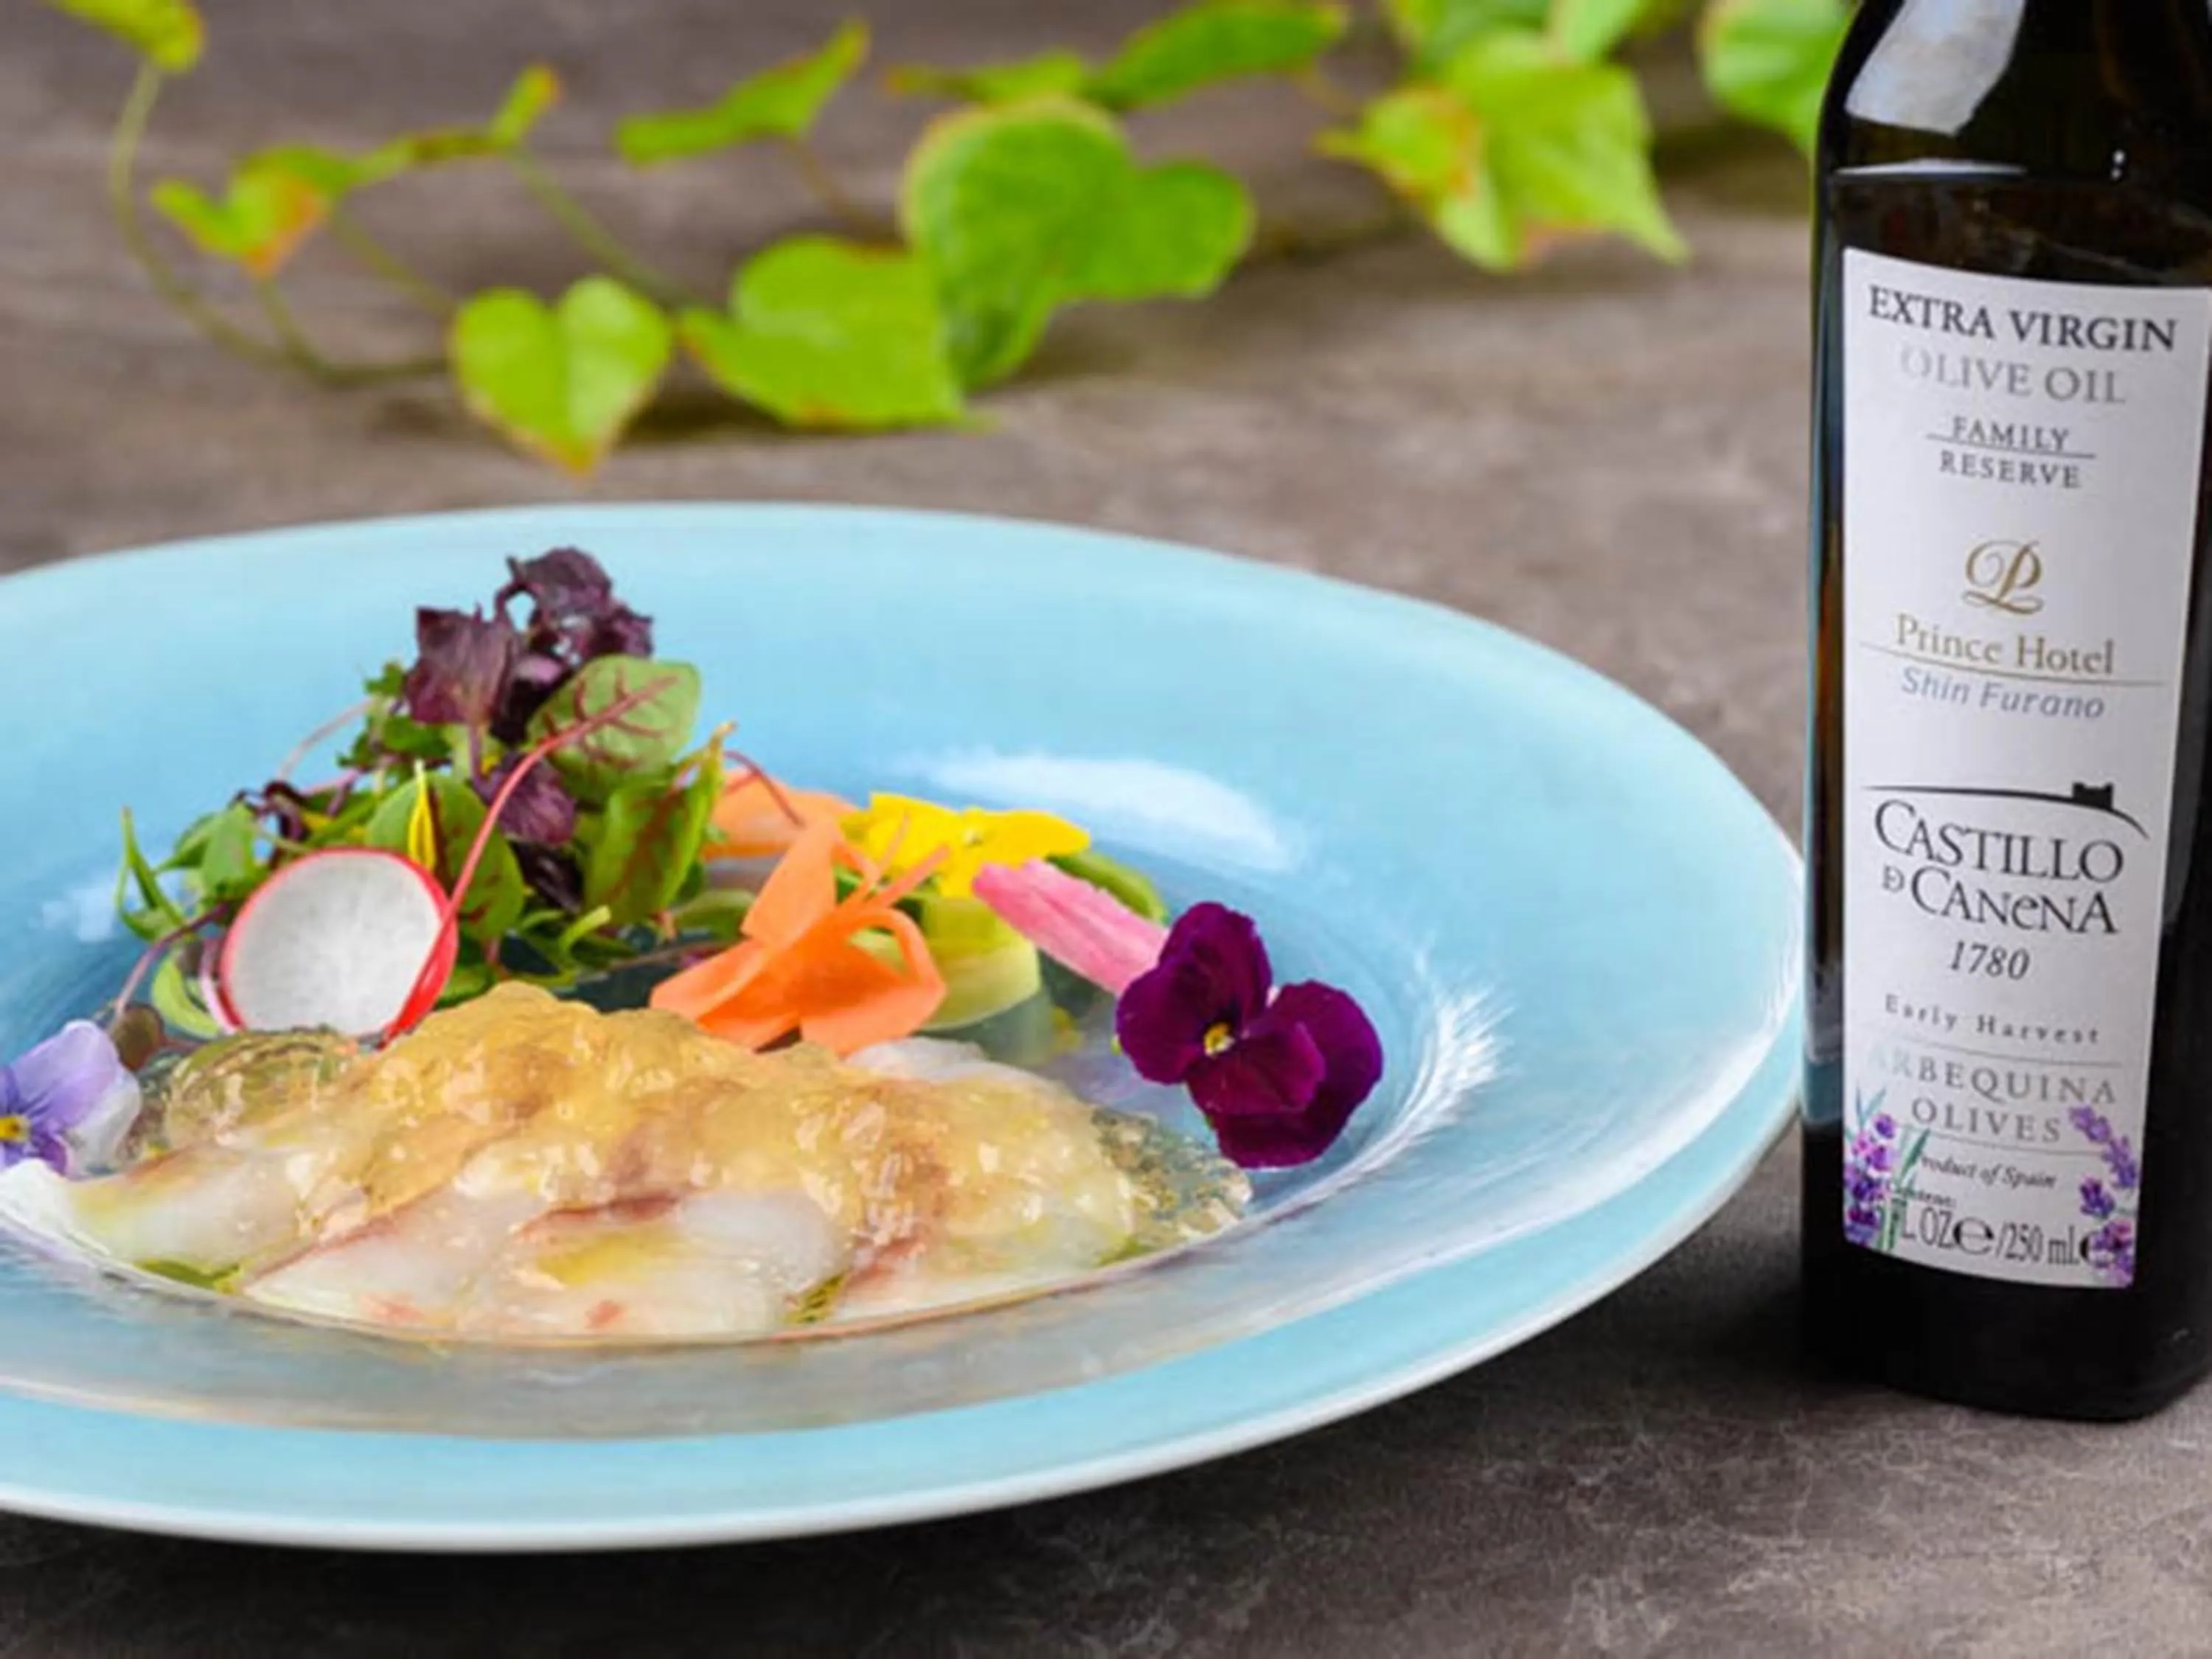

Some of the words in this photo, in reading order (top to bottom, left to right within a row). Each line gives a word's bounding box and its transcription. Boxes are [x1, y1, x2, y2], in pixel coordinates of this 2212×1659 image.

[1868, 285, 1994, 339] EXTRA
[2009, 310, 2178, 352] VIRGIN
[1900, 344, 2031, 397] OLIVE
[2045, 367, 2126, 404] OIL
[1952, 415, 2070, 451] FAMILY
[1940, 450, 2080, 489] RESERVE
[1896, 613, 2003, 663] Prince
[2017, 633, 2115, 674] Hotel
[1902, 667, 1969, 705] Shin
[1980, 681, 2104, 719] Furano
[1875, 799, 2124, 883] CASTILLO
[1948, 941, 2030, 980] 1780
[1885, 994, 1957, 1030] Early
[1978, 1015, 2098, 1043] Harvest
[1912, 1098, 2061, 1142] OLIVES
[1919, 1155, 1978, 1178] roduct
[1979, 1163, 2003, 1186] of
[2001, 1165, 2058, 1189] Spain
